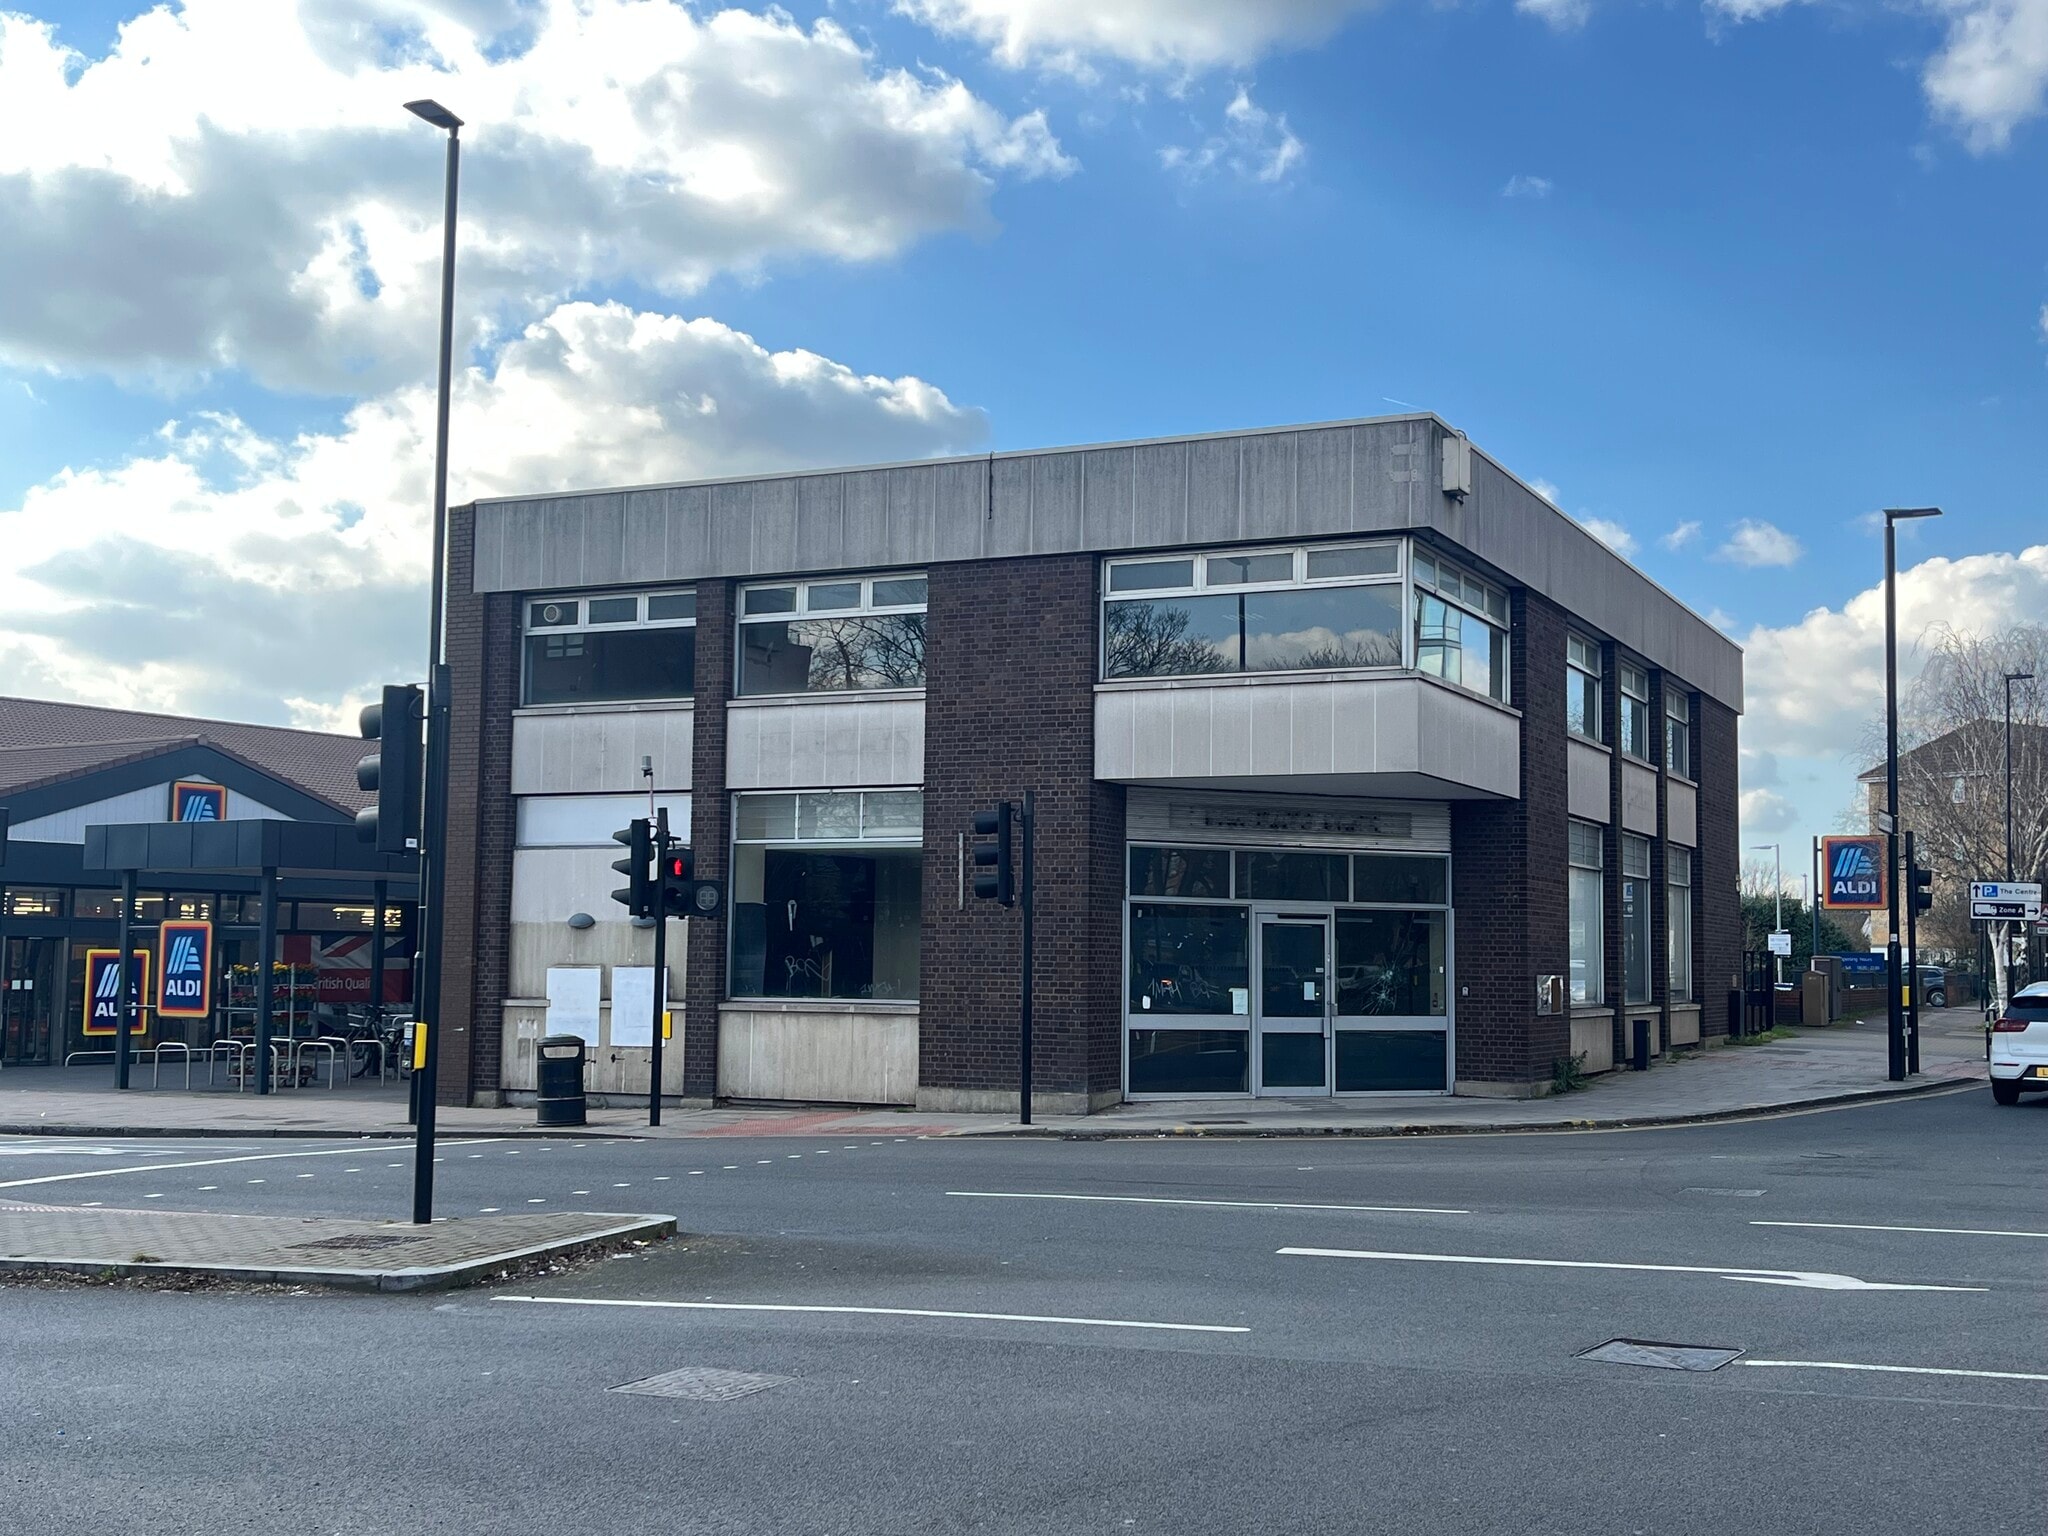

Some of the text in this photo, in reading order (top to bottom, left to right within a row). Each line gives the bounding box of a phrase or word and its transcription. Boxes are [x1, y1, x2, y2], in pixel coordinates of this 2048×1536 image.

[1833, 881, 1877, 894] ALDI
[165, 979, 201, 996] ALDI
[314, 977, 343, 990] ritish
[94, 1002, 137, 1017] ALI
